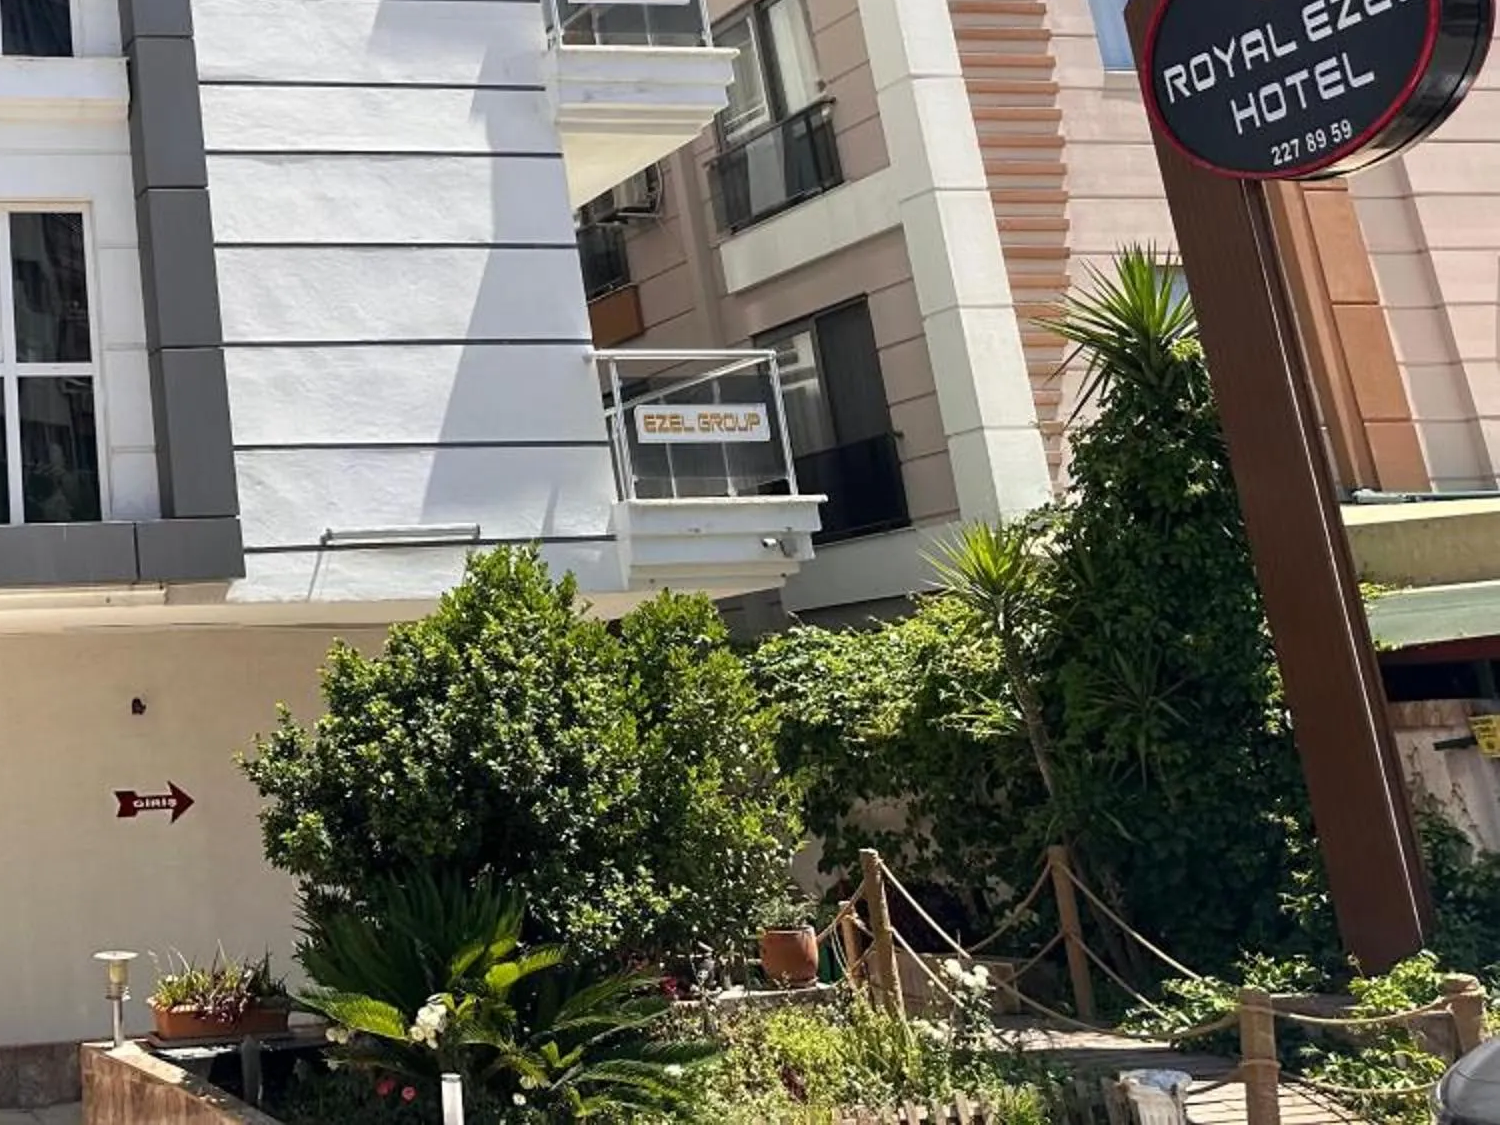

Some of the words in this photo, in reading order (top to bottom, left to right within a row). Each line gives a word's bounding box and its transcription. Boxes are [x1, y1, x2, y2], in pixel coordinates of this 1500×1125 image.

[1163, 23, 1298, 103] ROYAL
[1230, 52, 1375, 135] HOTEL
[1271, 138, 1300, 166] 227
[1306, 126, 1327, 153] 89
[1331, 119, 1352, 145] 59
[643, 413, 695, 433] EZEL
[697, 411, 760, 433] GROUP
